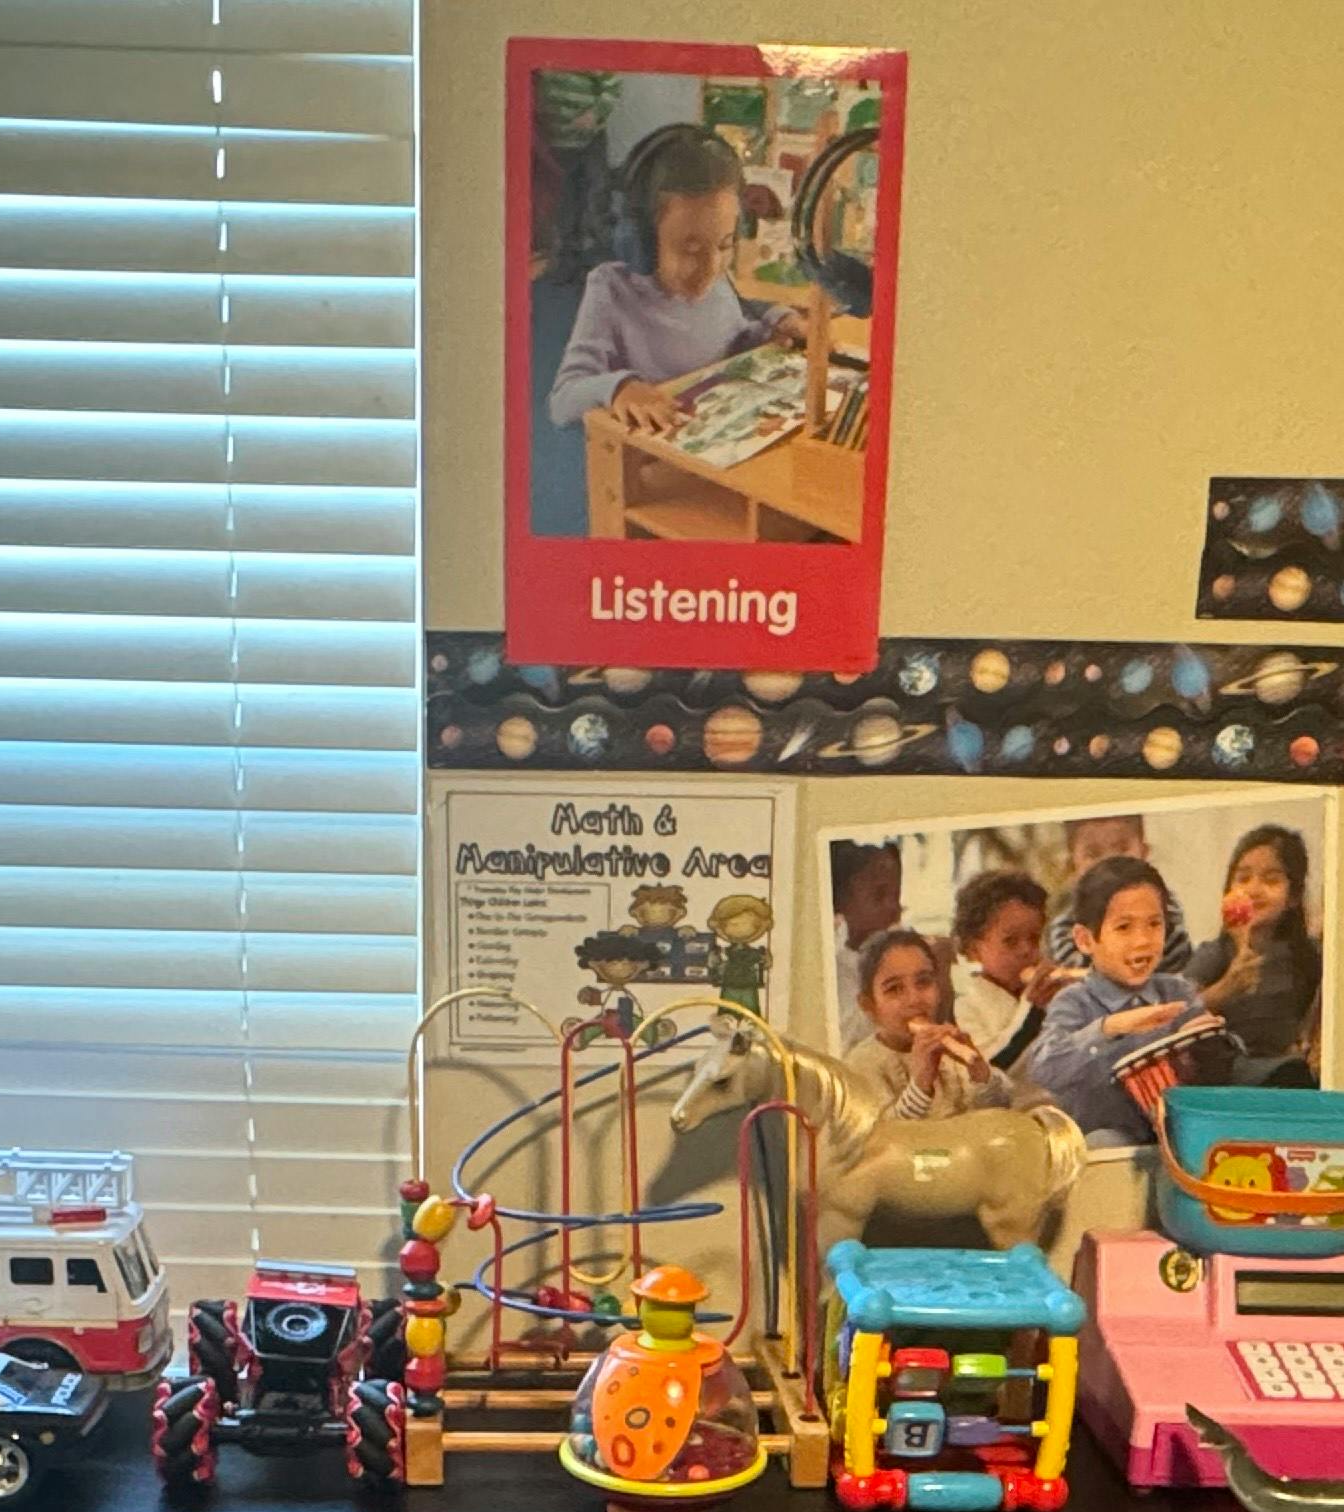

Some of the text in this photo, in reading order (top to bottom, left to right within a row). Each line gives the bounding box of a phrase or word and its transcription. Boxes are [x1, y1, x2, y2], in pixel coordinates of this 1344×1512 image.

[590, 577, 798, 636] Listening
[552, 803, 677, 836] Math &
[457, 842, 771, 880] Manipulative Area
